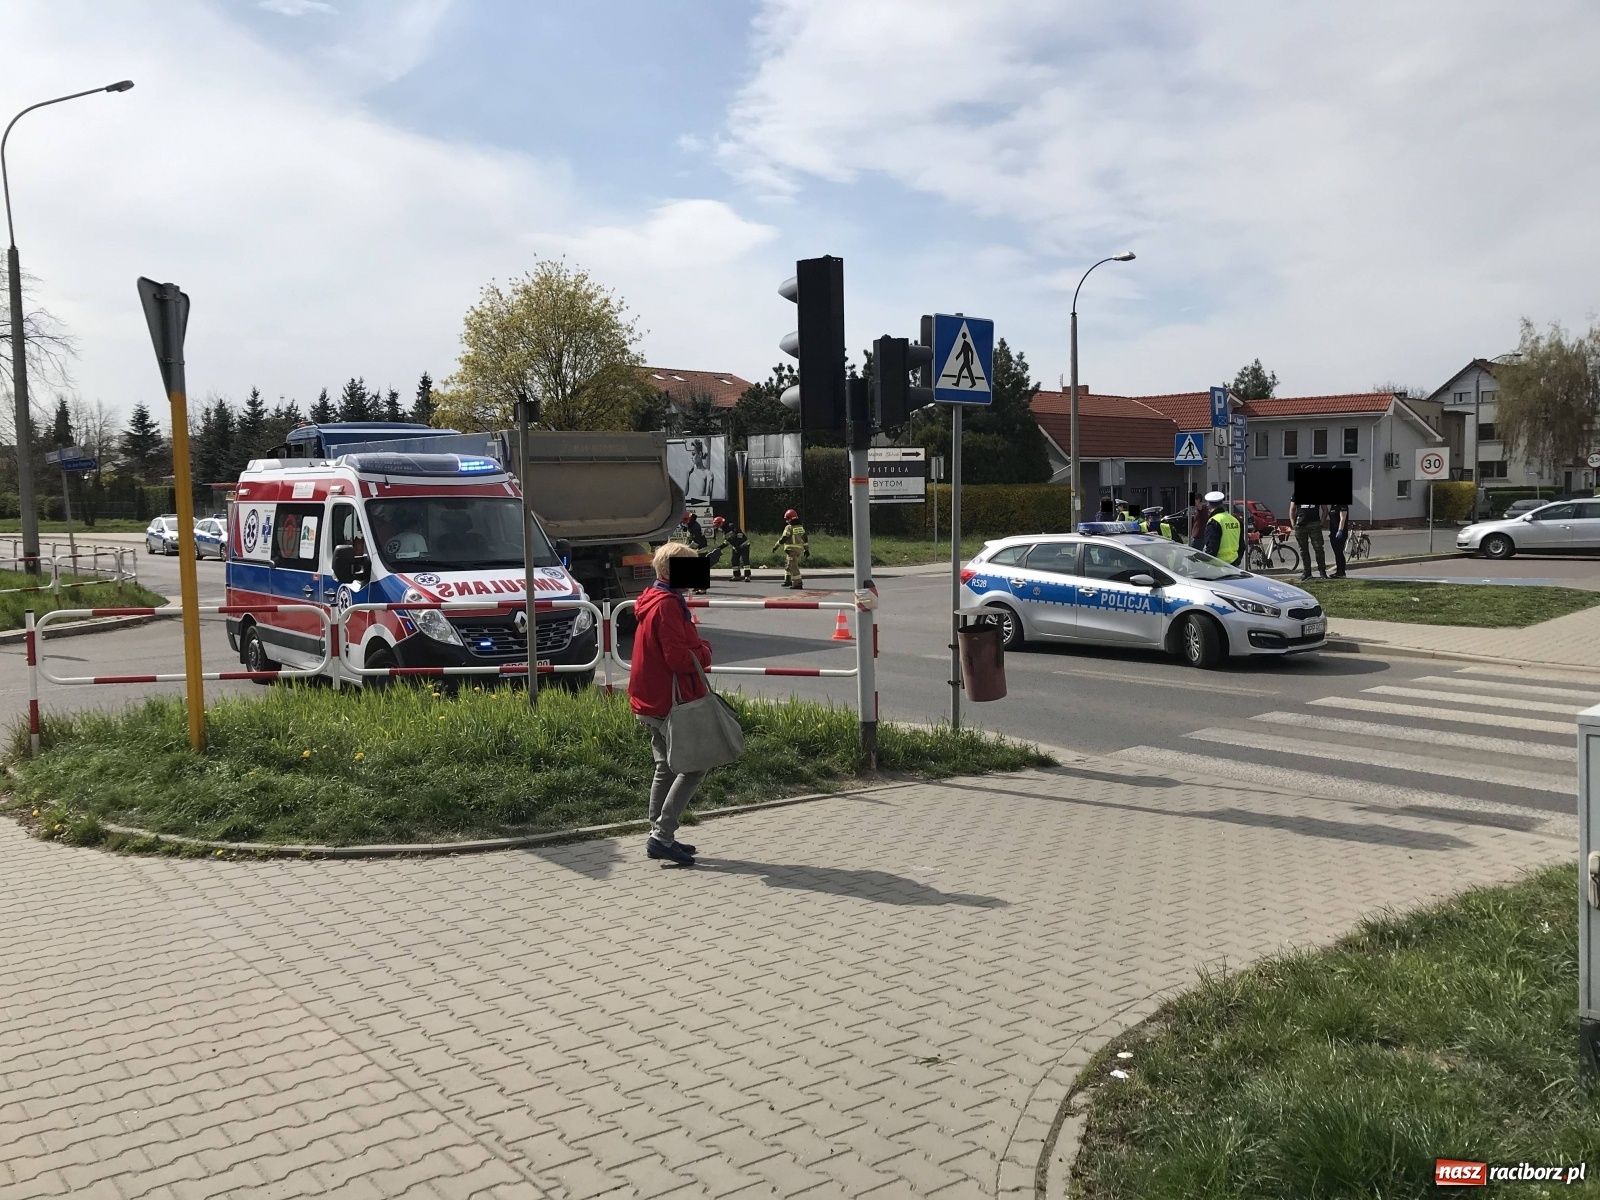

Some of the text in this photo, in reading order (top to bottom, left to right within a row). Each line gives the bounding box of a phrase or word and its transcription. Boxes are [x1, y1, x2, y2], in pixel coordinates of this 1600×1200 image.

[1214, 390, 1224, 415] P
[1424, 458, 1440, 469] 30
[873, 480, 903, 488] BYTOM
[972, 578, 988, 588] R528
[1100, 594, 1150, 610] POLICJA
